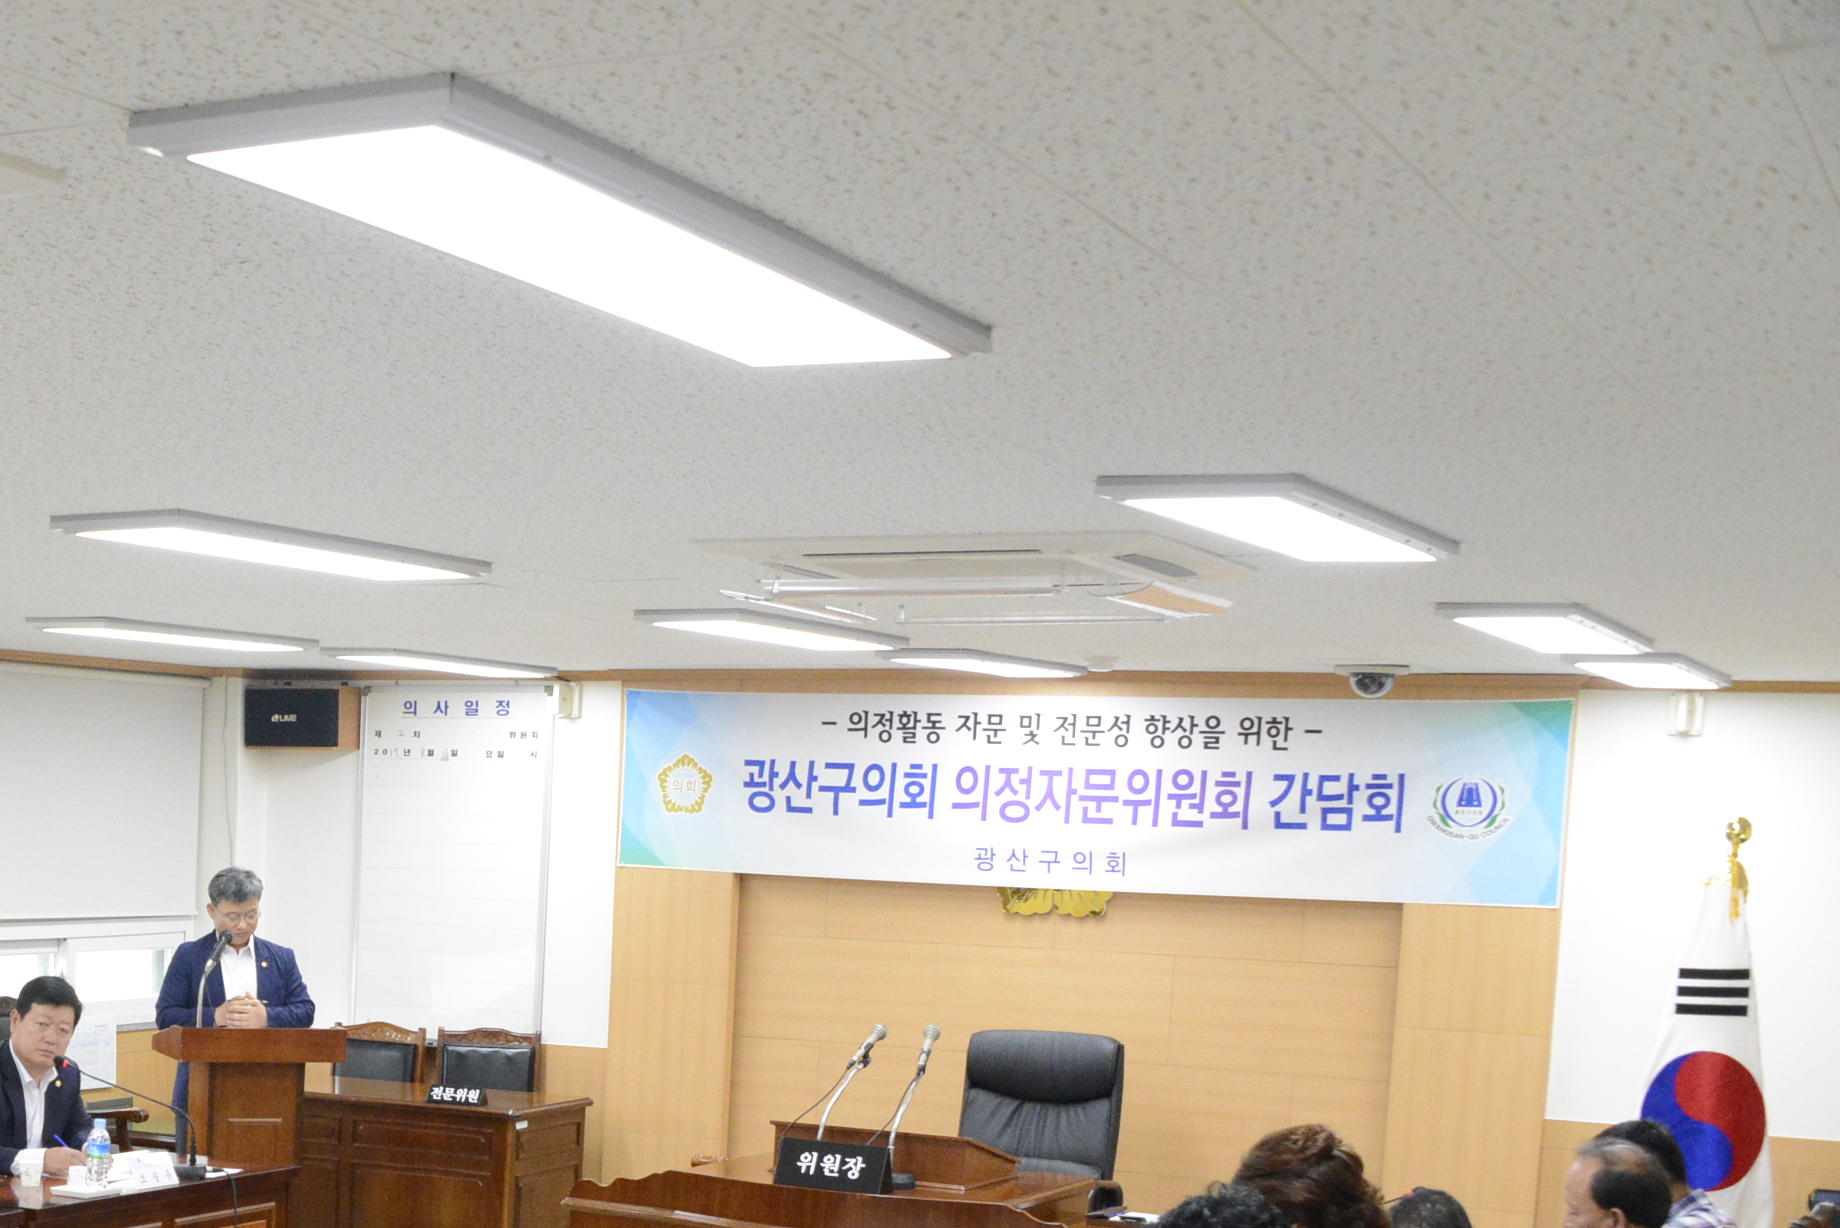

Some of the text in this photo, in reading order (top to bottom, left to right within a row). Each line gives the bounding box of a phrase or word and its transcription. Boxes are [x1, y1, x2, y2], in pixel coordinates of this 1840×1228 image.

[403, 699, 510, 717] 의사일정
[847, 710, 946, 744] 의정활동
[955, 711, 1007, 744] 자문
[1019, 713, 1041, 746] 및
[1053, 713, 1132, 748] 전문성
[1144, 714, 1226, 750] 향상을
[1237, 715, 1294, 751] 위한
[743, 759, 1406, 833] 광산구의회 의정자문위원회 간담회
[974, 847, 1127, 877] 광산구의회
[430, 1086, 480, 1103] 전문위원
[796, 1151, 866, 1180] 위원장
